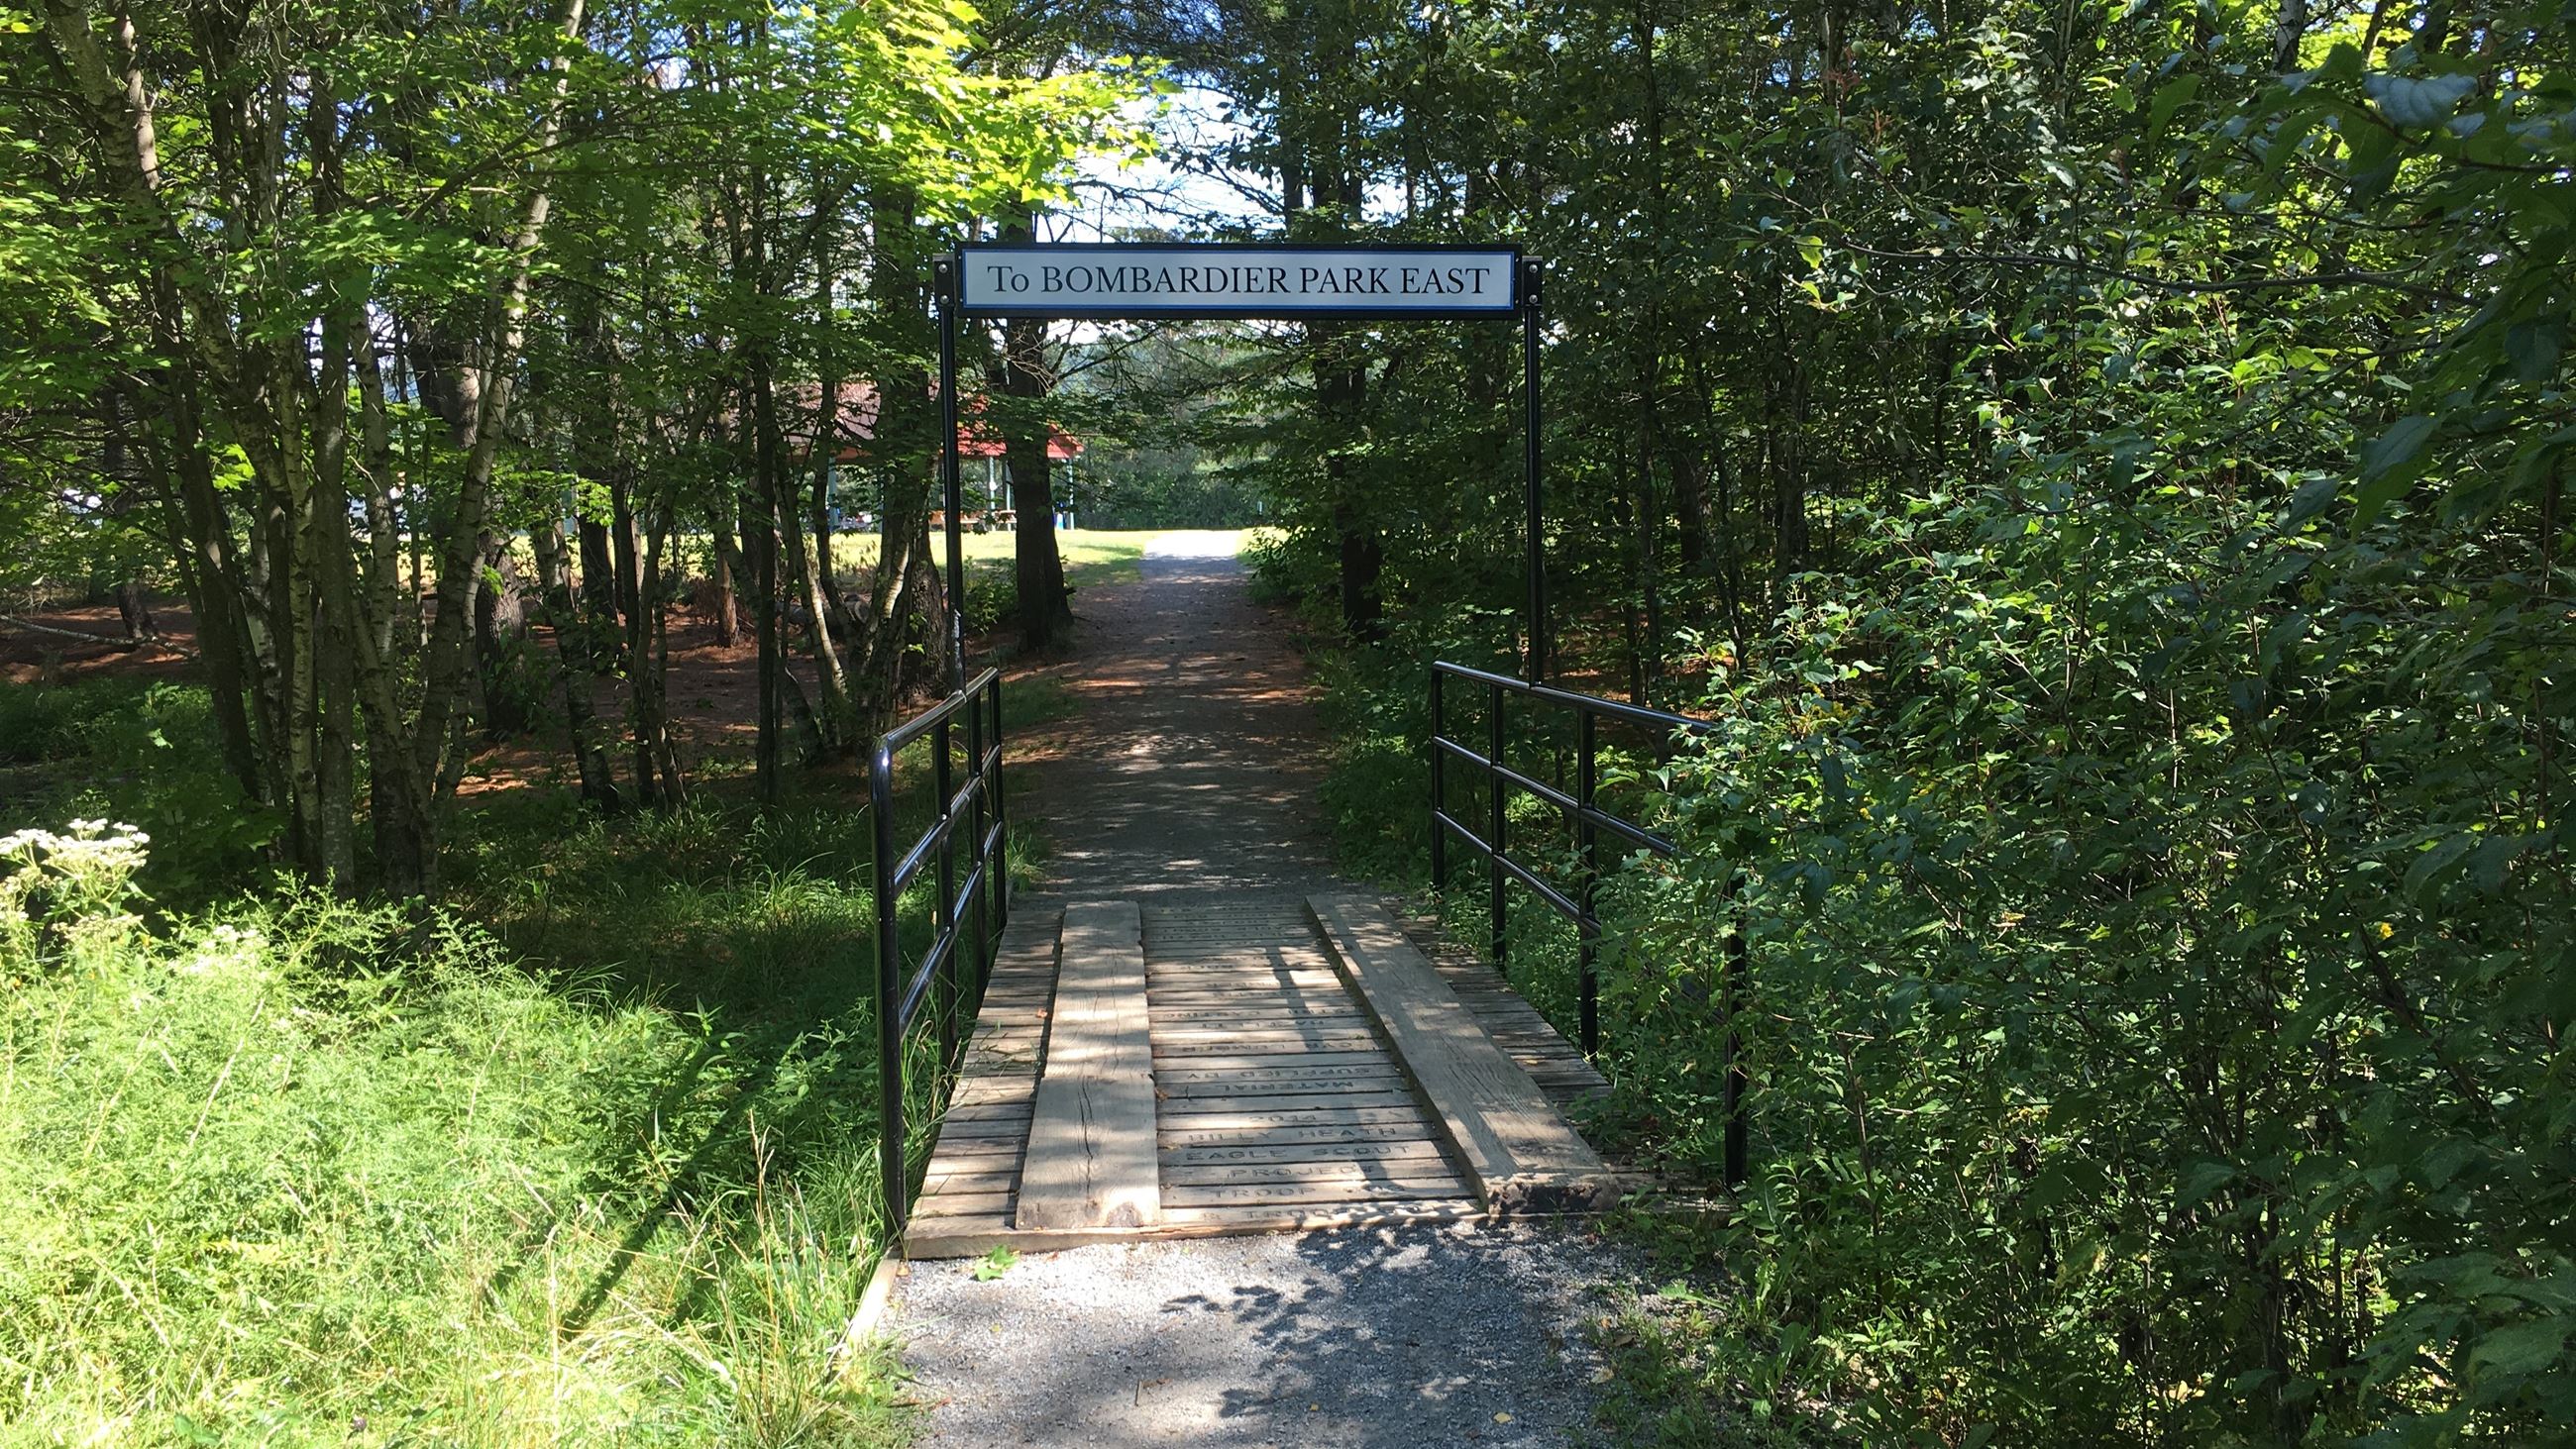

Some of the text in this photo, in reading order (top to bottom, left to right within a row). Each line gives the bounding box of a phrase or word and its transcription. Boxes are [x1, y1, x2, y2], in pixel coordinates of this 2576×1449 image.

[987, 266, 1491, 294] To BOMBARDIER PARK EAST
[1240, 1068, 1371, 1078] SUPPLIED
[1224, 1081, 1354, 1091] MATERIAL
[1249, 1114, 1317, 1124] 2014
[1189, 1127, 1397, 1143] BILLY HEATH
[1187, 1145, 1411, 1161] EAGLE SCOUT
[1231, 1165, 1375, 1179] PROJECT
[1213, 1189, 1317, 1199] TROOP
